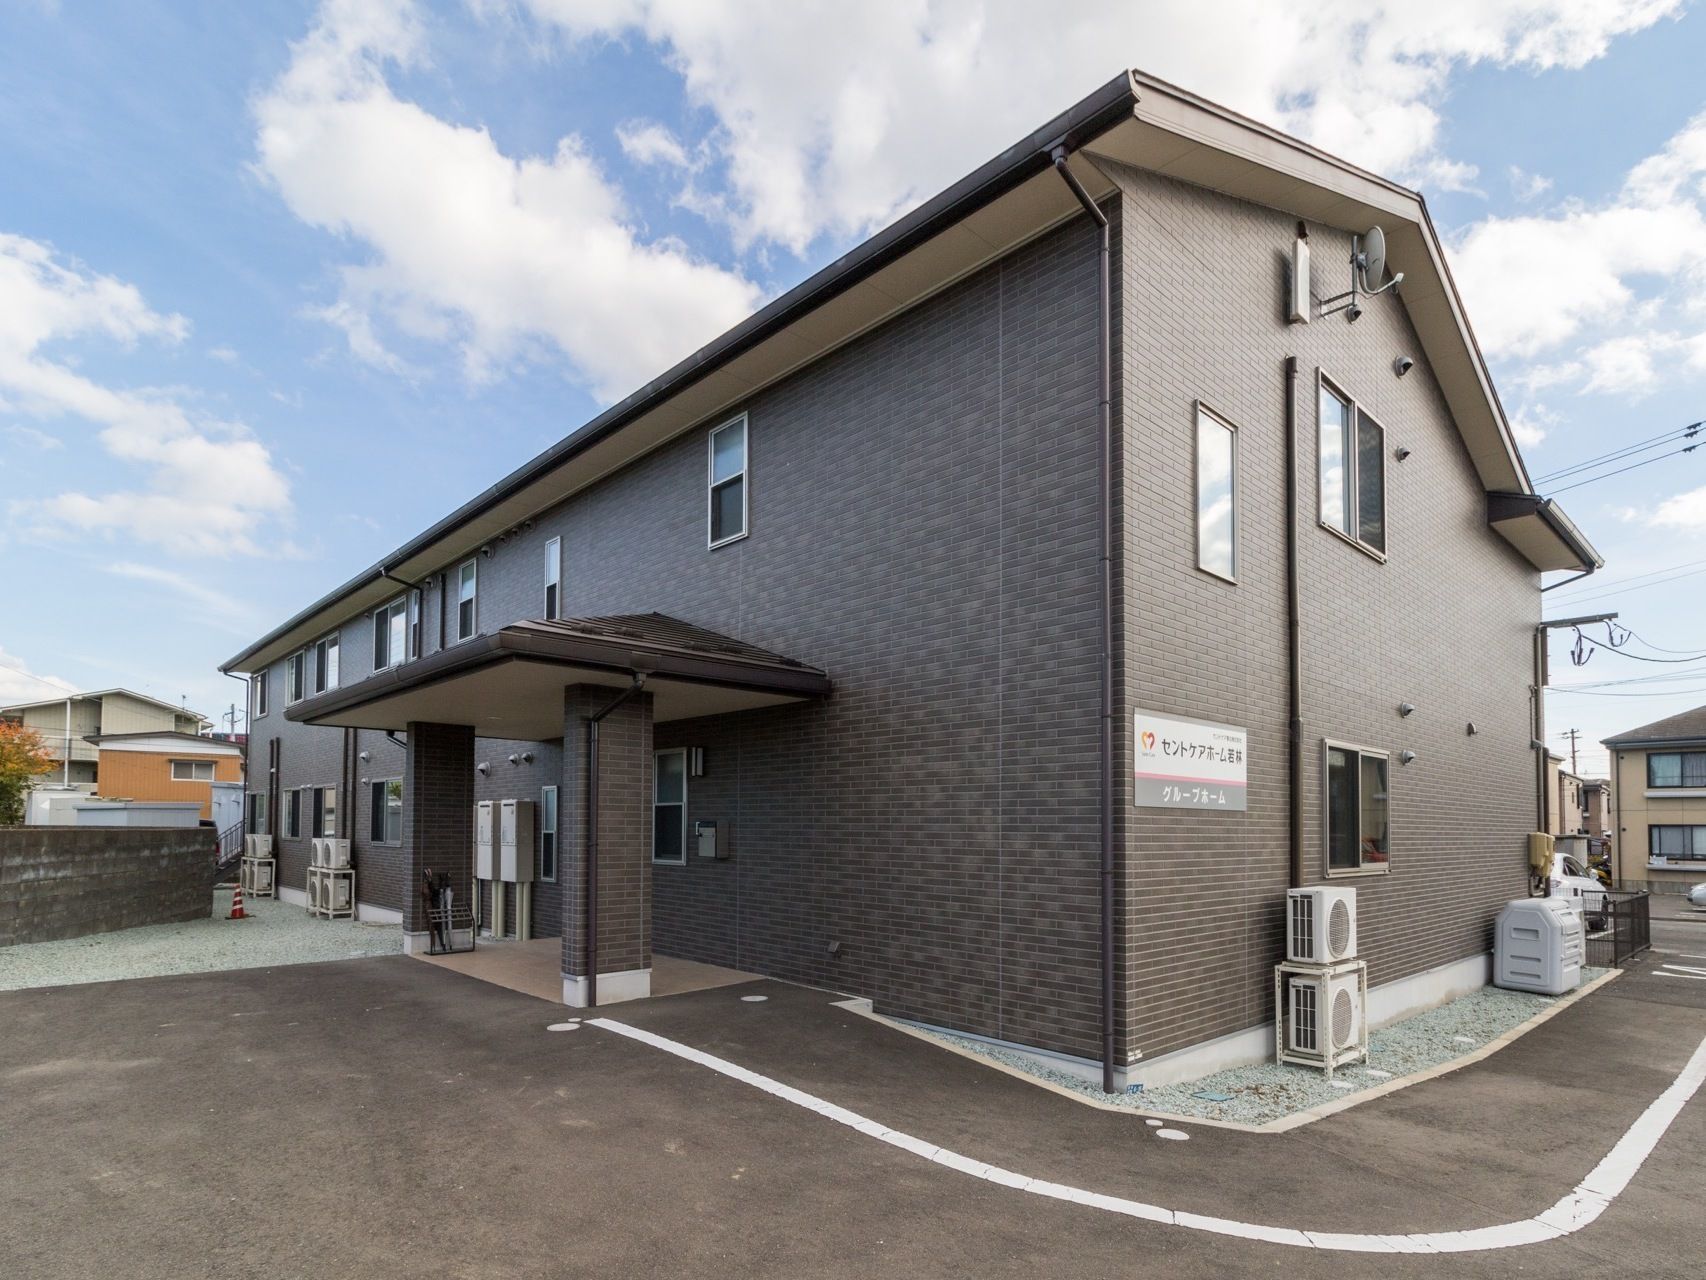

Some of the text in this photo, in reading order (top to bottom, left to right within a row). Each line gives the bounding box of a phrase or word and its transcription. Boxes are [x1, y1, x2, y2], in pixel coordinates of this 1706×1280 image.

[1162, 739, 1242, 764] セントケアホーム若林
[1163, 785, 1226, 804] グループホーム
